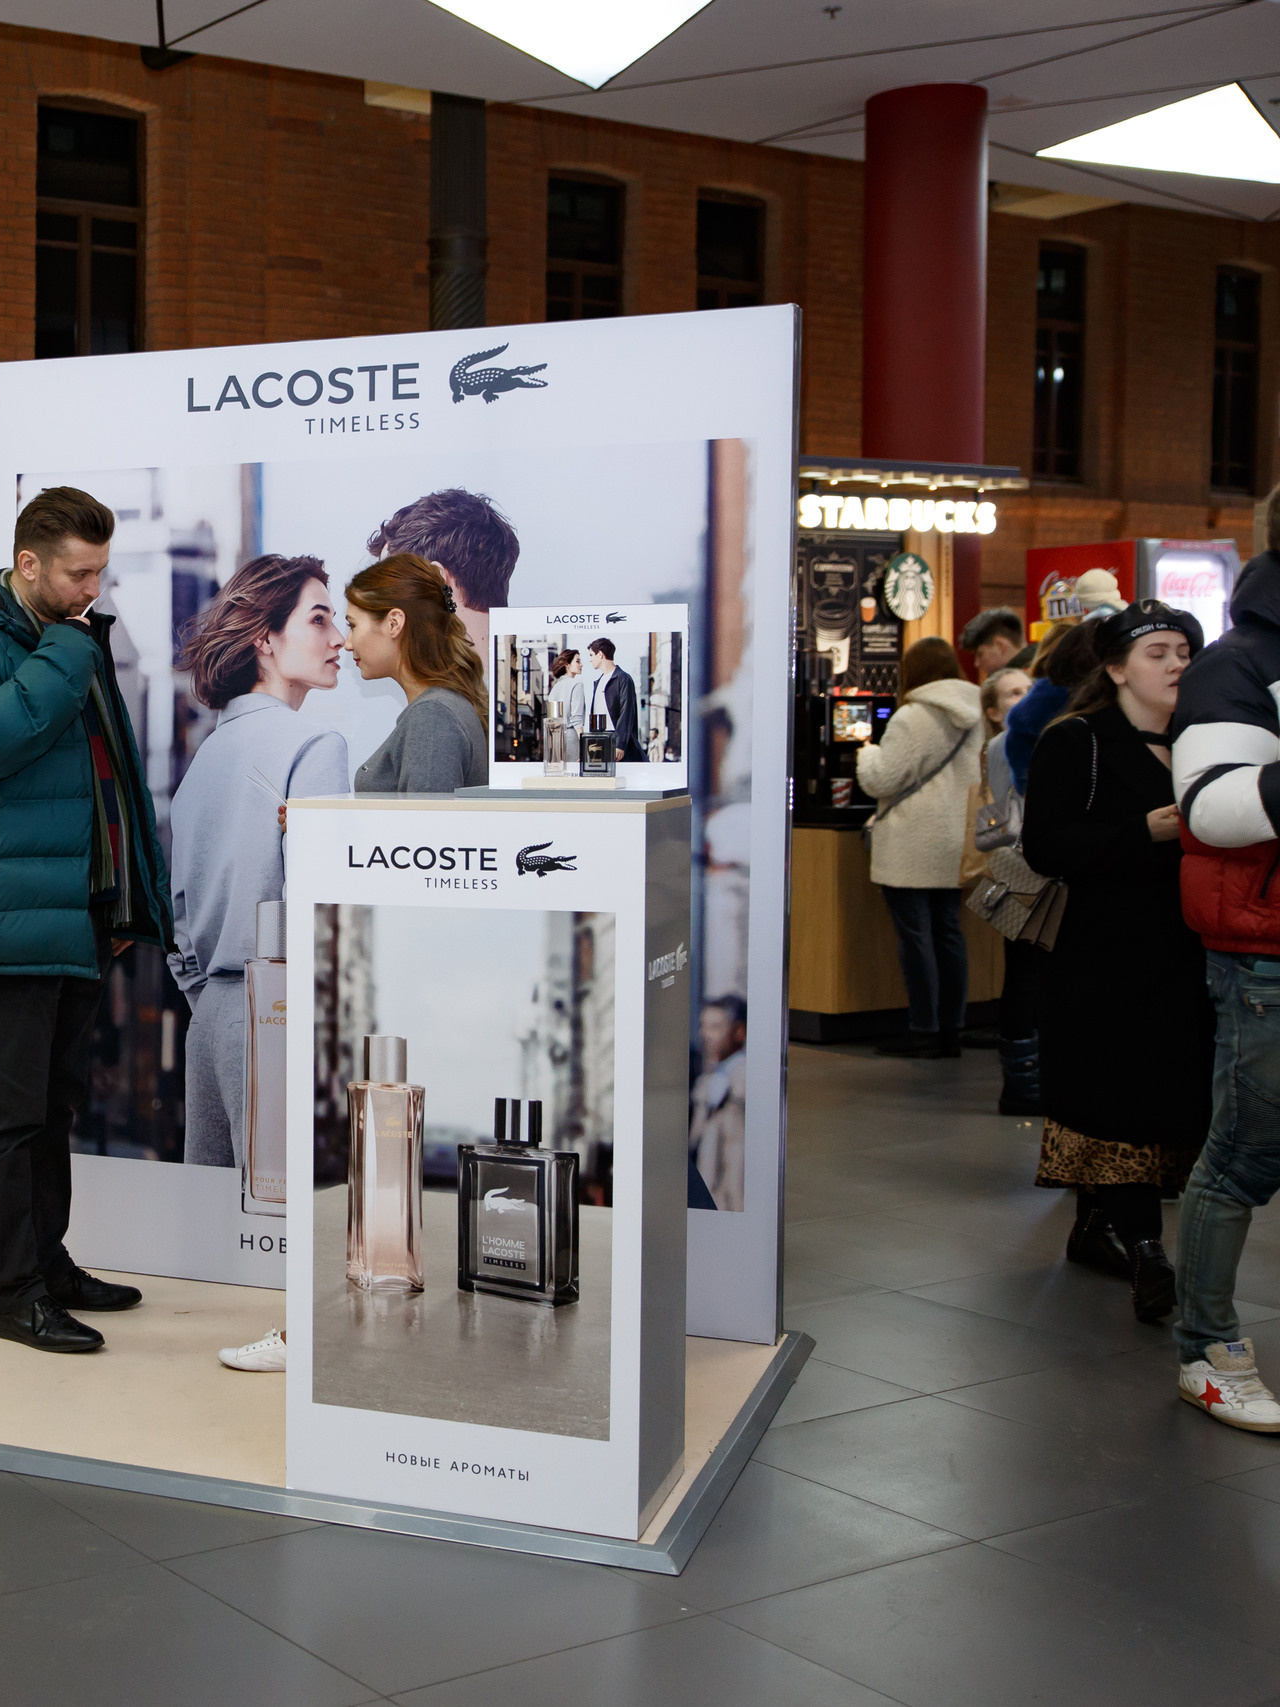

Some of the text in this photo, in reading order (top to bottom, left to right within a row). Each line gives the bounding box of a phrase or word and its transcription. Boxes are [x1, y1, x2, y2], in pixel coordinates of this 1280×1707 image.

[187, 363, 420, 413] LACOSTE
[305, 413, 420, 435] TIMELESS
[798, 494, 997, 535] STARBUCKS
[546, 614, 600, 624] LACOSTE
[348, 845, 498, 871] LACOSTE
[424, 877, 498, 890] TIMELESS
[259, 1015, 287, 1025] LACO
[375, 1130, 413, 1139] LACOSTE
[255, 1176, 275, 1184] POUR
[482, 1235, 526, 1250] L'HOMME
[482, 1245, 526, 1260] LACOSTE
[484, 1257, 524, 1269] TIMELESS
[385, 1452, 529, 1481] НОВЫЕ АРОМАТЫ
